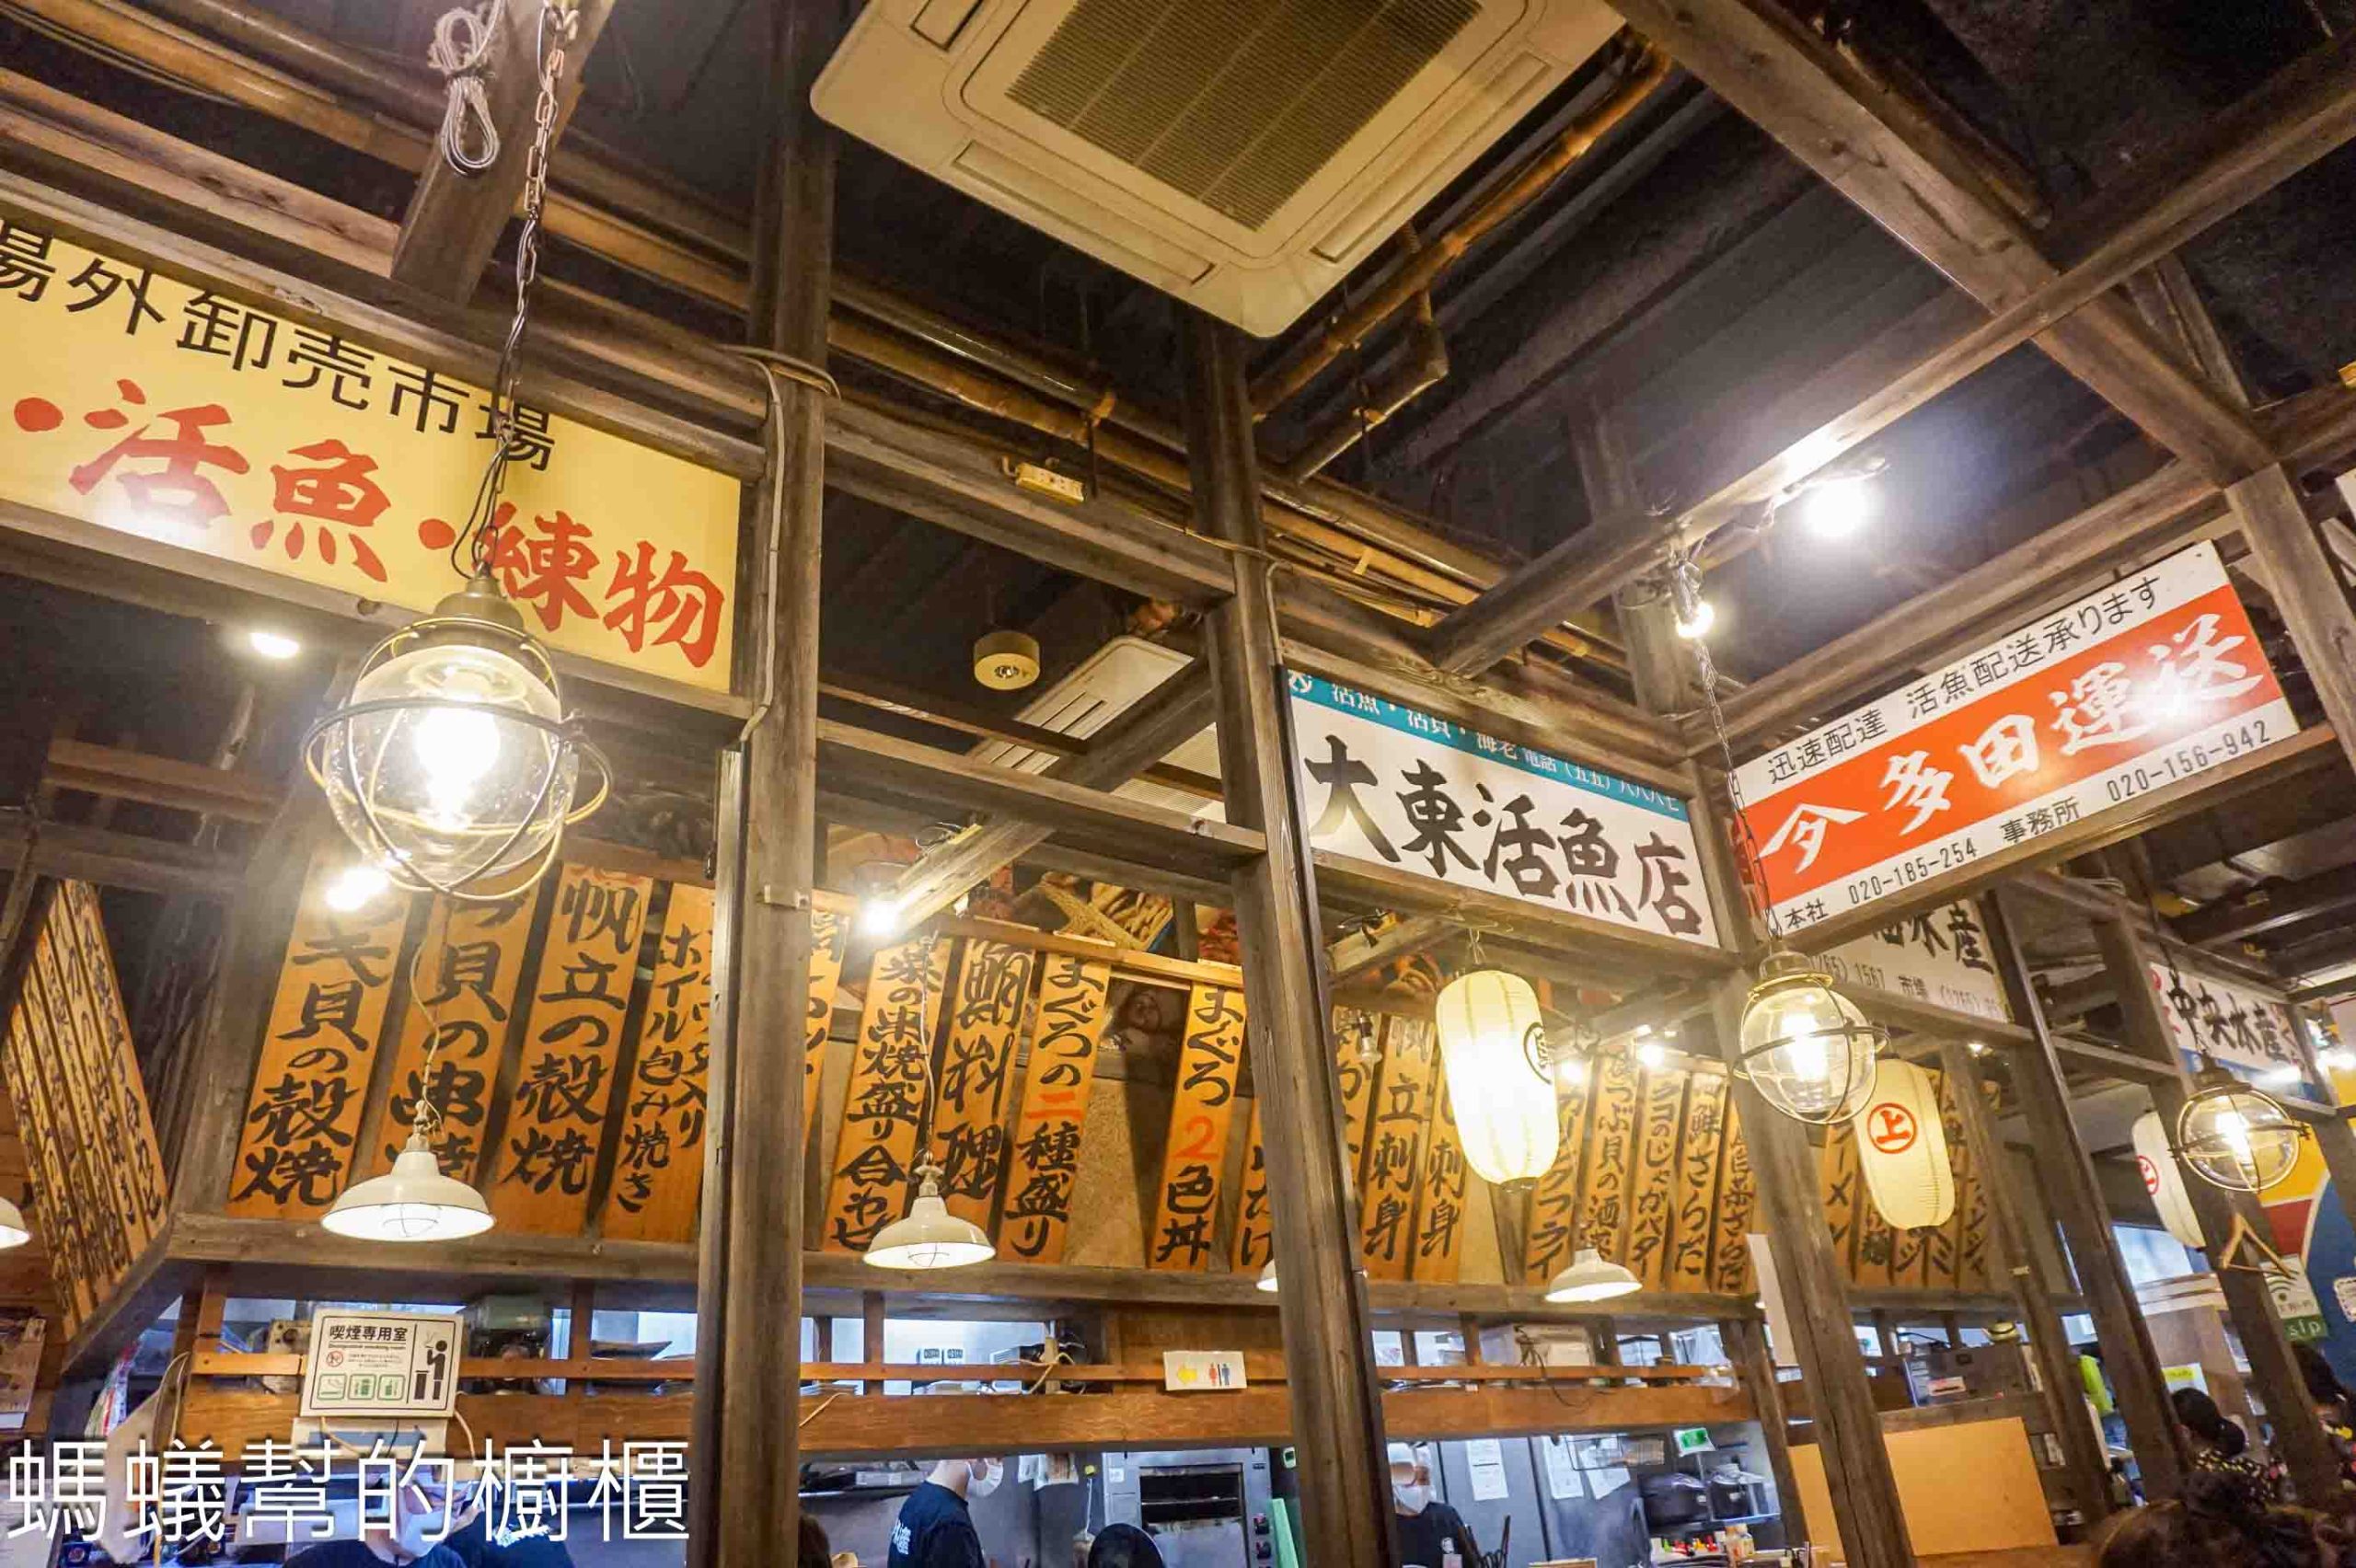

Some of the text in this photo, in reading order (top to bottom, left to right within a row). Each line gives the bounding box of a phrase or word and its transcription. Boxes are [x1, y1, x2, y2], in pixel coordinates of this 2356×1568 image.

[1767, 575, 2161, 785] 迅速配達 活魚配送承ります
[1878, 614, 2263, 837] 多田運送
[1304, 734, 1703, 936] 大東活魚店
[1784, 718, 2272, 930] 本社 020-185-254 事務所 020-156-942
[329, 1325, 409, 1342] 喫煙専用室
